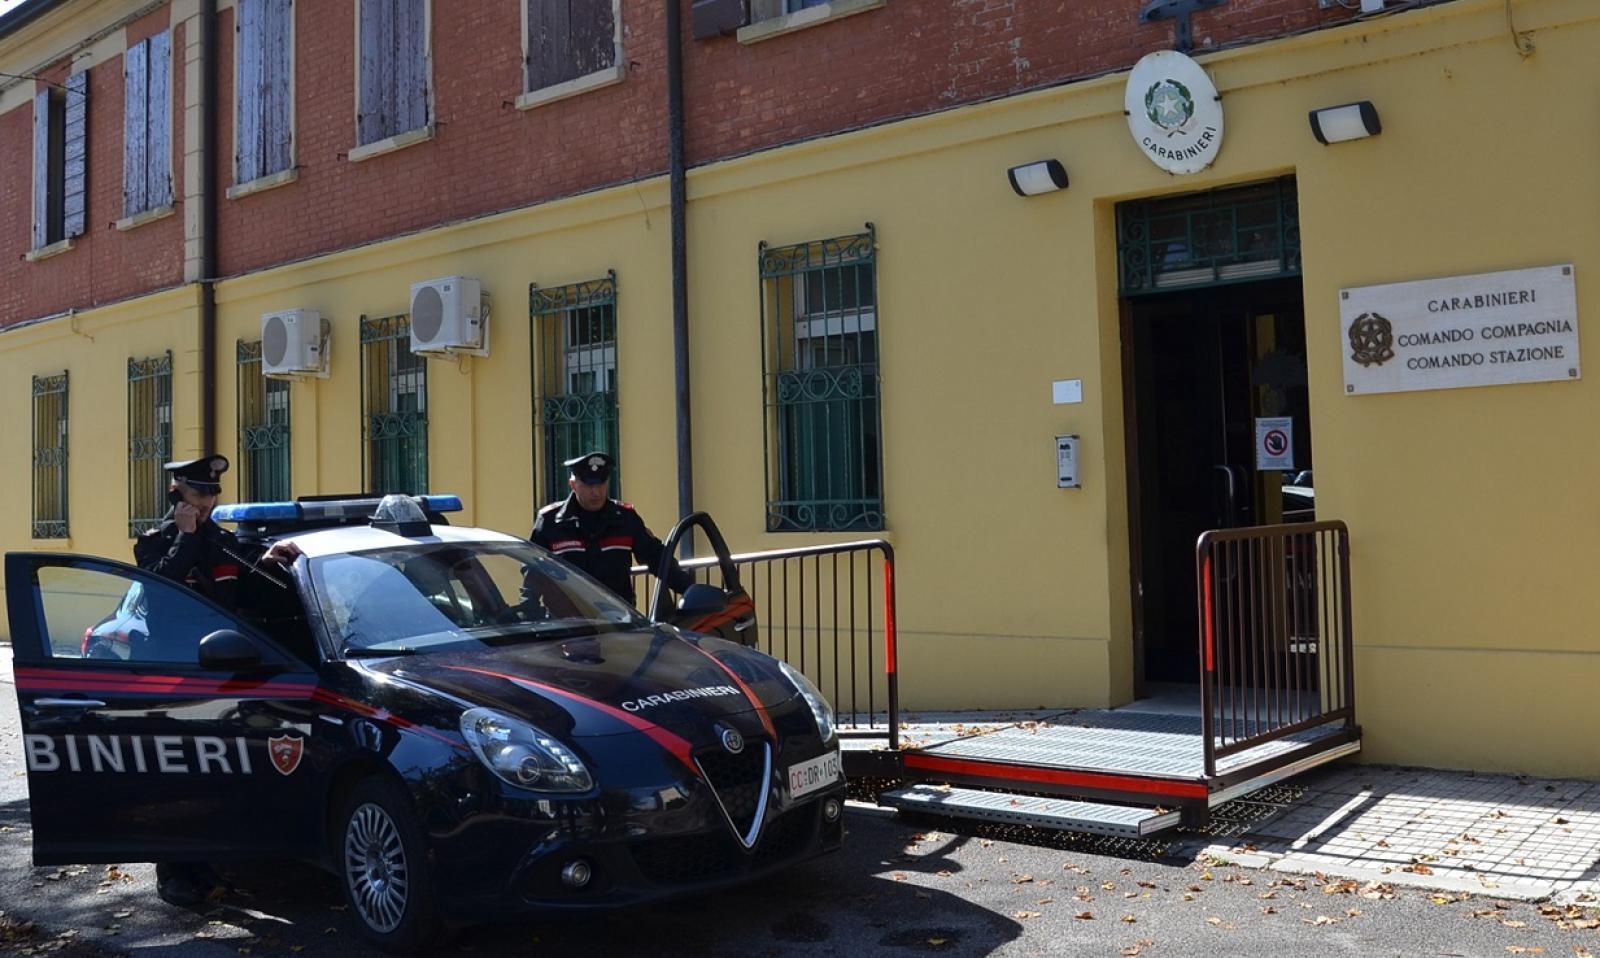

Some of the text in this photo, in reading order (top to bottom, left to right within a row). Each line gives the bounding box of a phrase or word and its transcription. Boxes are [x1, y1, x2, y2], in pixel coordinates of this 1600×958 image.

[1142, 126, 1217, 161] CARABINIERI
[1428, 289, 1537, 313] CARABINIERI
[1398, 319, 1573, 347] COMANDO COMPAGNIA
[1407, 345, 1565, 370] COMANDO STAZIONE
[621, 685, 741, 712] CARABINIERI
[24, 734, 253, 774] BINIERI
